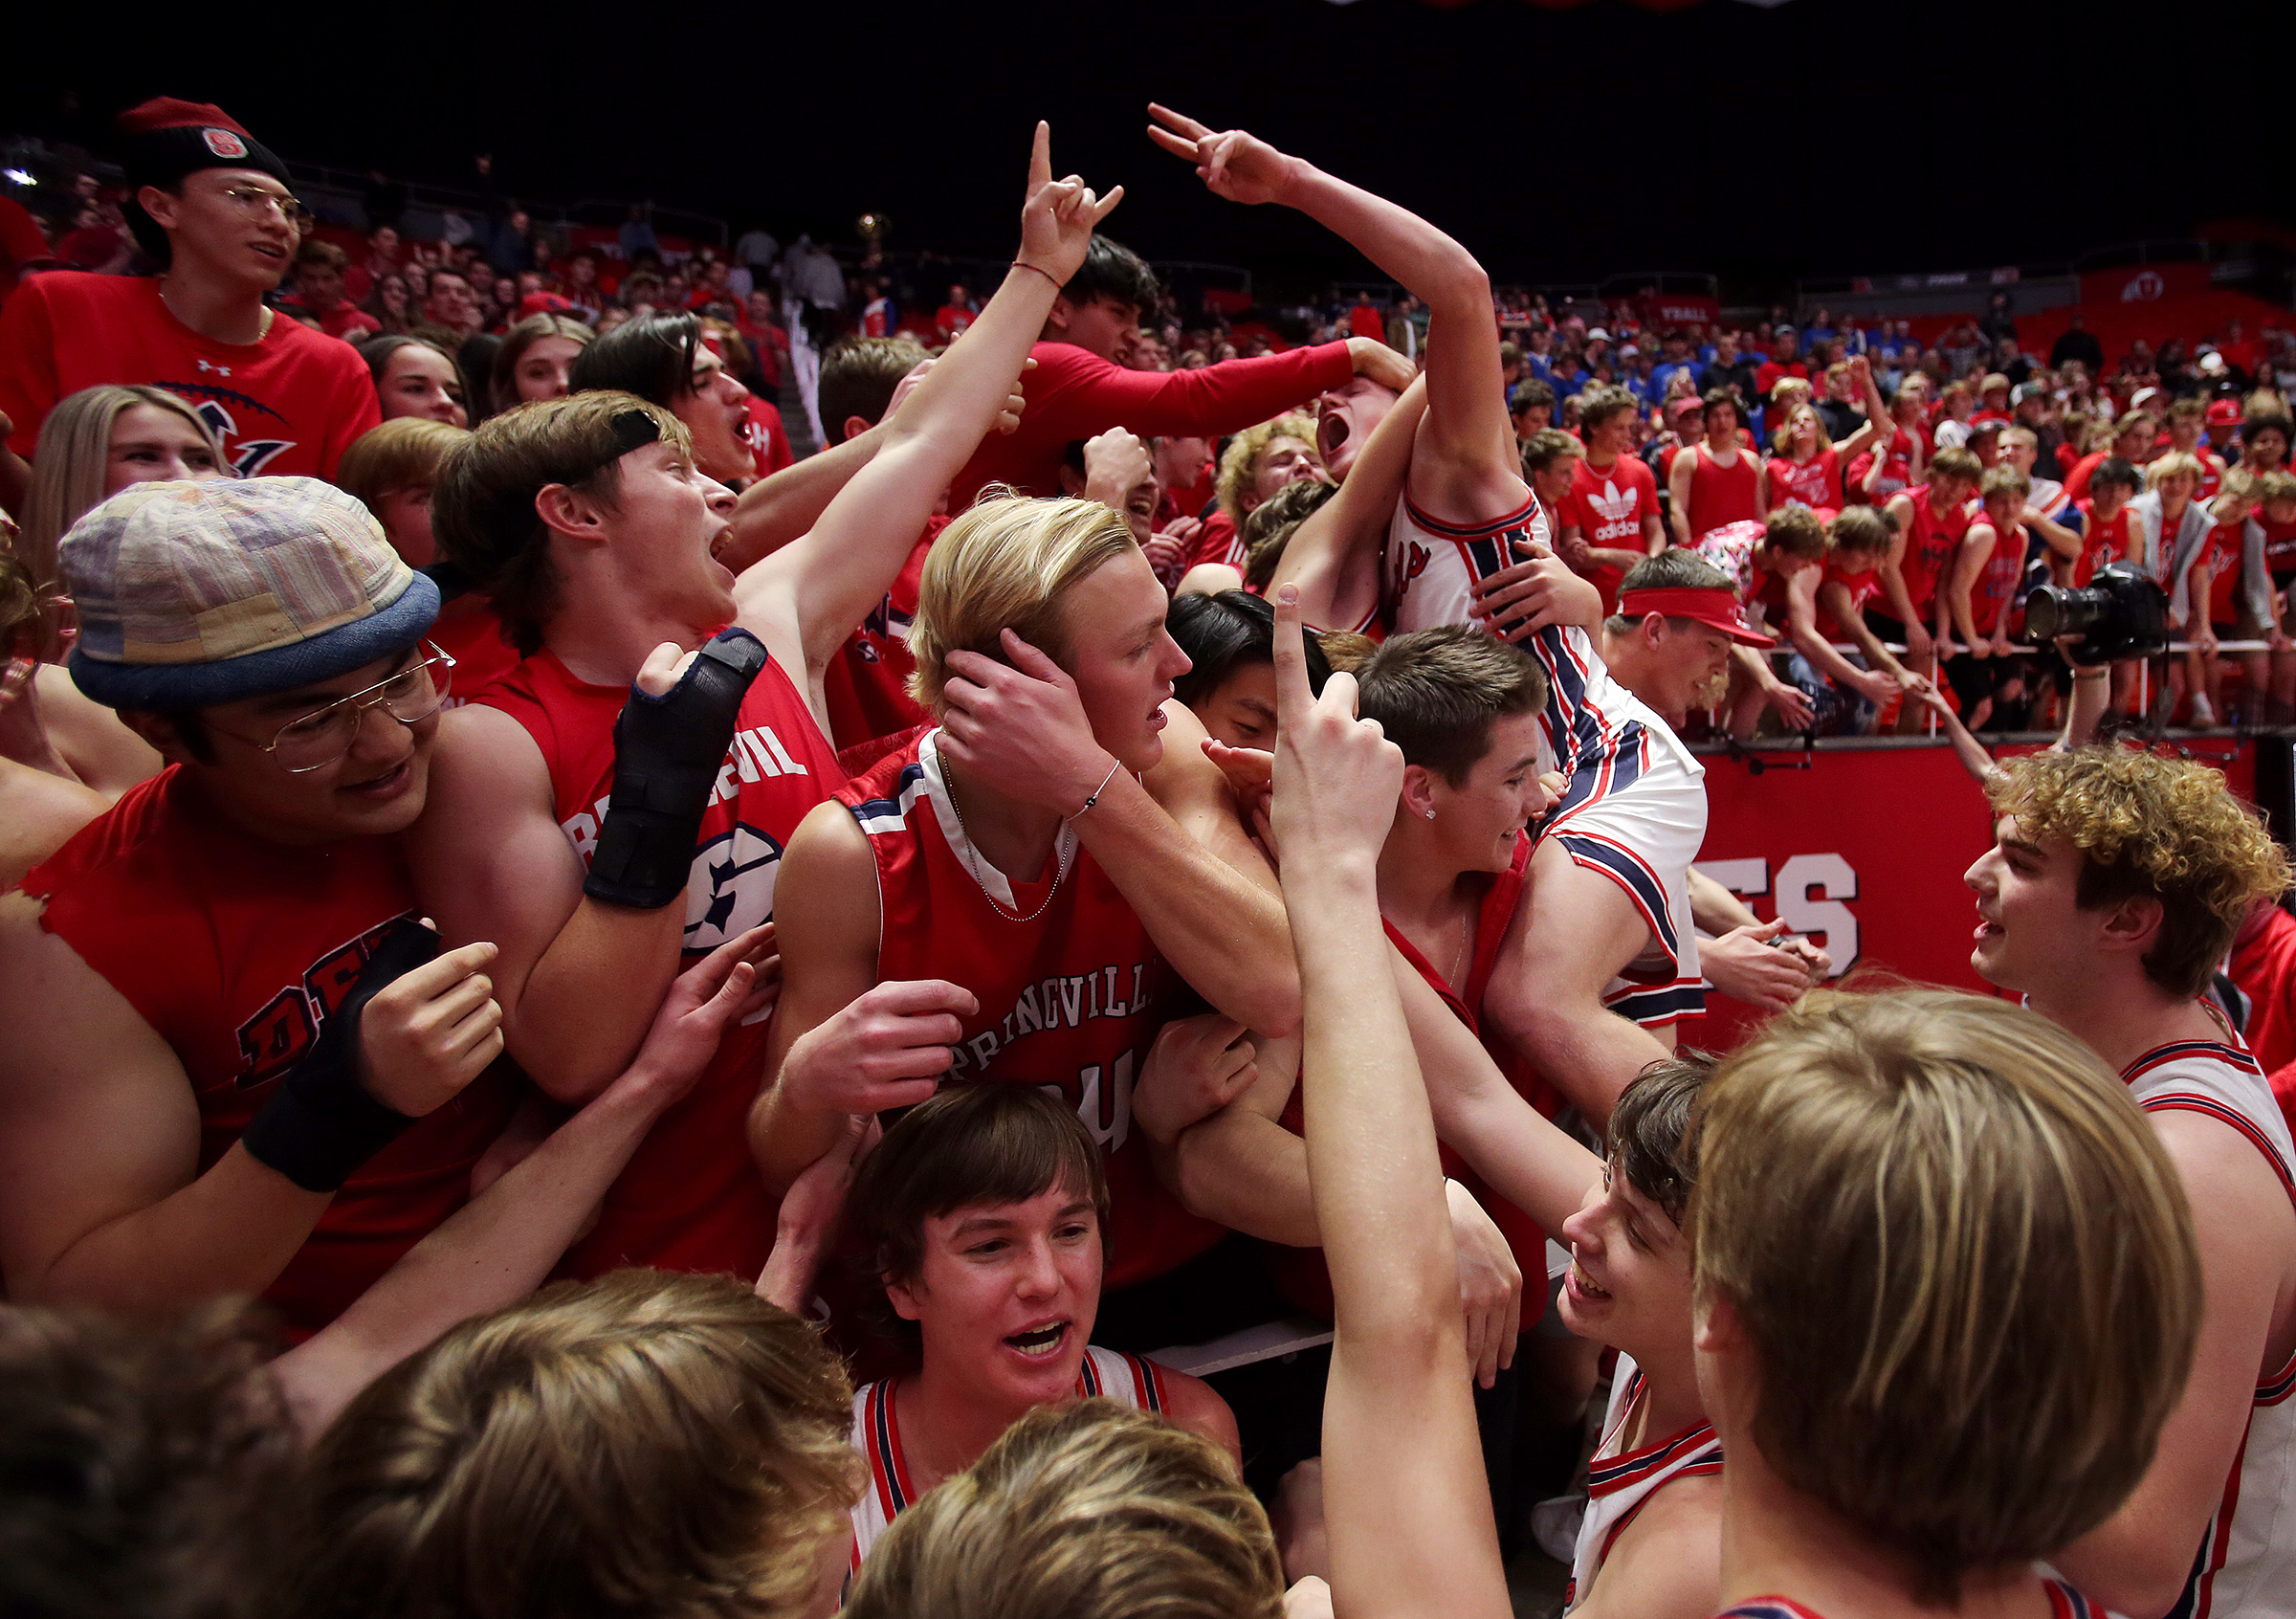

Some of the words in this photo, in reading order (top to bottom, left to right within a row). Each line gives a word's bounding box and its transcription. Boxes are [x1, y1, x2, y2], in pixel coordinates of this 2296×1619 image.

[1595, 521, 1640, 541] adidas
[708, 725, 808, 807] EVIL
[938, 958, 1155, 1083] PRINGVILL
